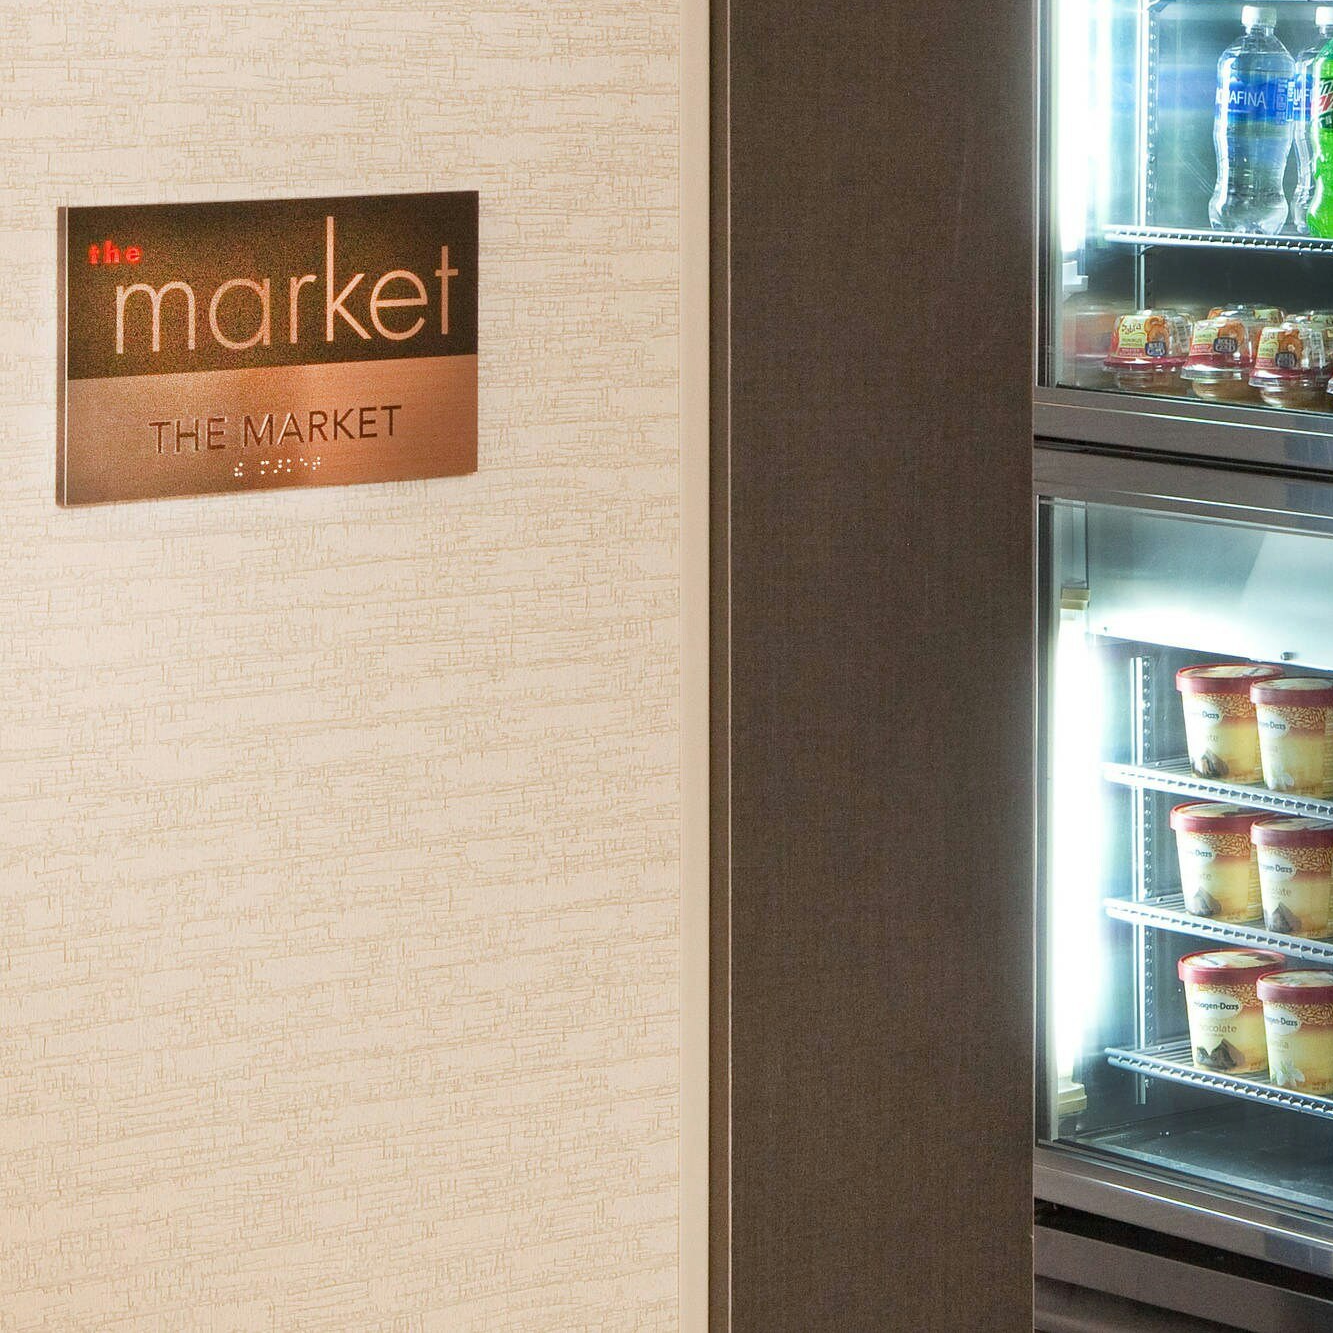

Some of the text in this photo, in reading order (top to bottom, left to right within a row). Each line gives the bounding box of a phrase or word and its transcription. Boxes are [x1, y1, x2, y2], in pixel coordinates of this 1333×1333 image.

[88, 240, 143, 265] the
[115, 216, 459, 354] market
[149, 417, 227, 455] THE
[243, 405, 402, 448] MARKET
